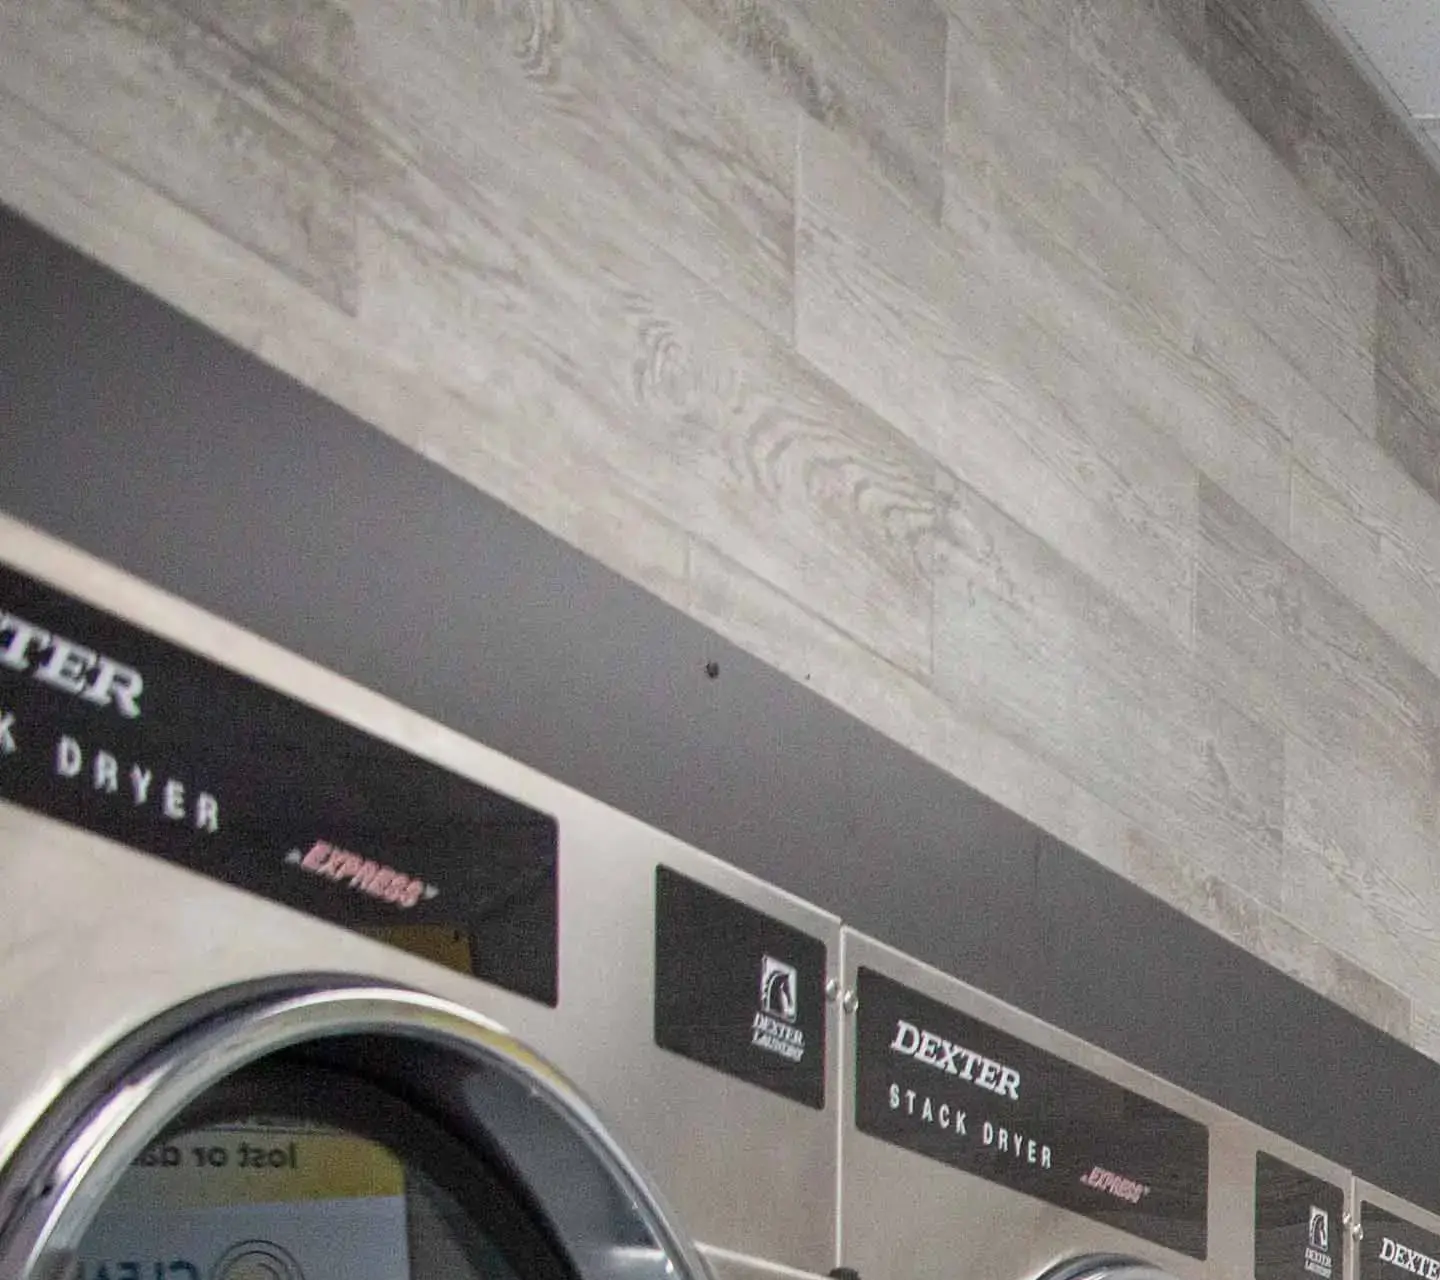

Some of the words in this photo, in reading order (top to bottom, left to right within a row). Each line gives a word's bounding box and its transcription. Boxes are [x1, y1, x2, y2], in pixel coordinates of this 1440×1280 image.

[0, 612, 144, 719] TER
[56, 736, 218, 833] DRYER
[891, 1020, 1021, 1100] DEXTER
[889, 1083, 967, 1136] STACK
[982, 1121, 1052, 1170] DRYER
